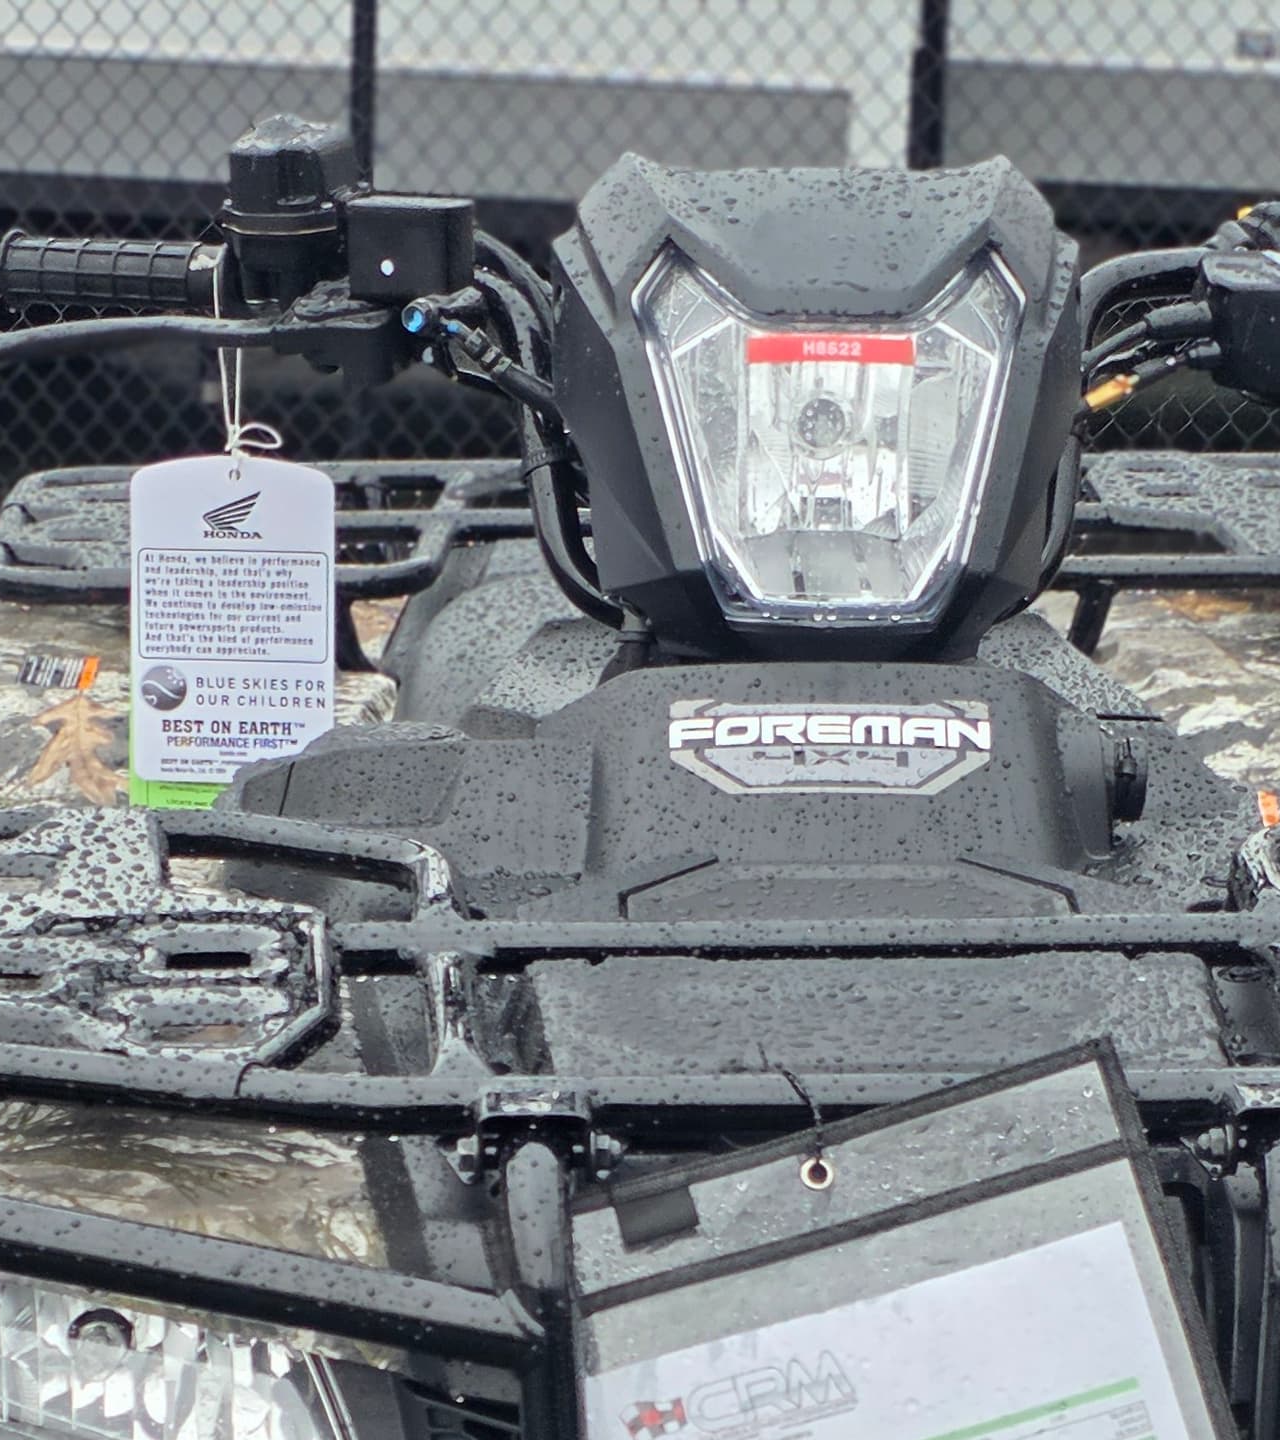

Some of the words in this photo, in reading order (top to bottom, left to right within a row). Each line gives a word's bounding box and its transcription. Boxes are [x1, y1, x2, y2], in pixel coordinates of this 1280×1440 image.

[203, 530, 262, 540] HONDA
[196, 677, 236, 689] BLUE
[242, 678, 288, 690] SKIES
[295, 680, 326, 691] FOR
[196, 694, 230, 706] OUR
[237, 695, 325, 708] CHILDREN
[162, 719, 204, 734] BEST
[210, 720, 231, 734] ON
[669, 715, 991, 750] FOREMAN
[167, 736, 250, 748] PERFORMANCE
[688, 1348, 857, 1429] CRM
